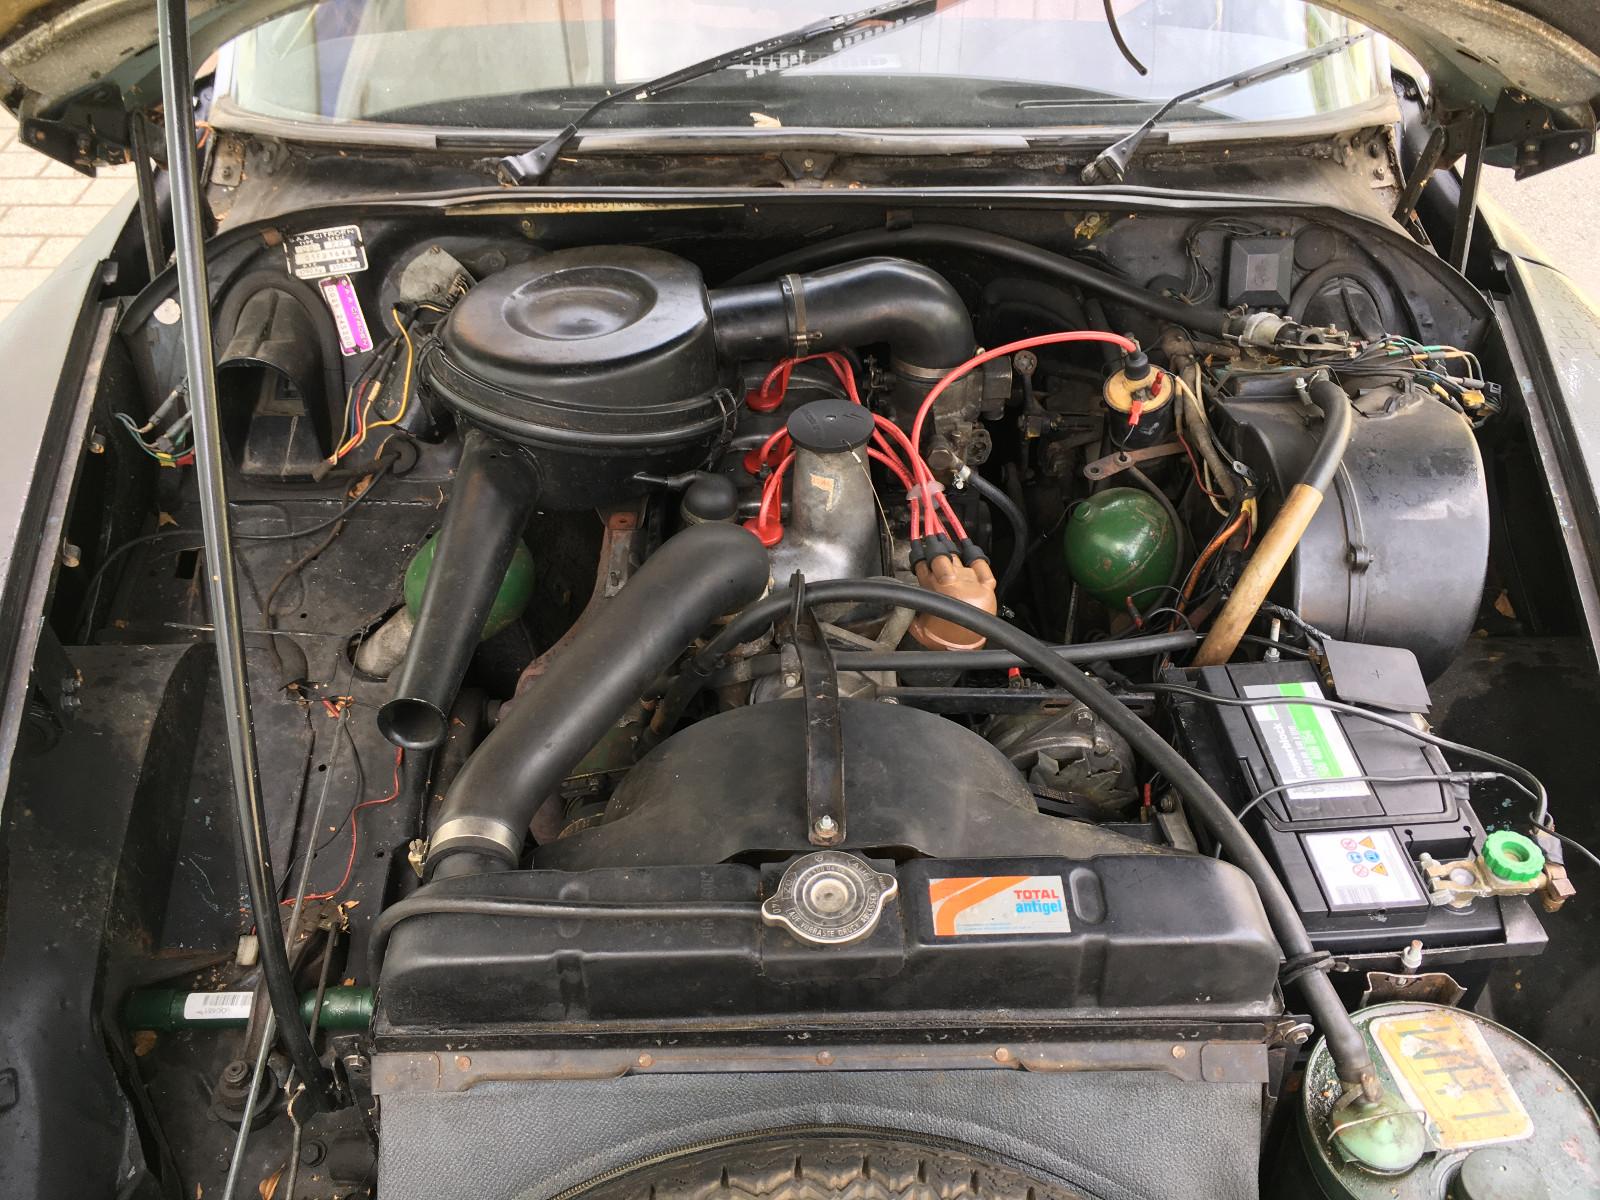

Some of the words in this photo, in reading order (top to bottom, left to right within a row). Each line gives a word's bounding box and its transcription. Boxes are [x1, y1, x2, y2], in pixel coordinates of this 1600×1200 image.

[1014, 889, 1059, 900] TOTAL
[1016, 899, 1063, 915] antigel
[800, 922, 835, 937] VORRASTE
[1397, 1024, 1511, 1121] LHM
